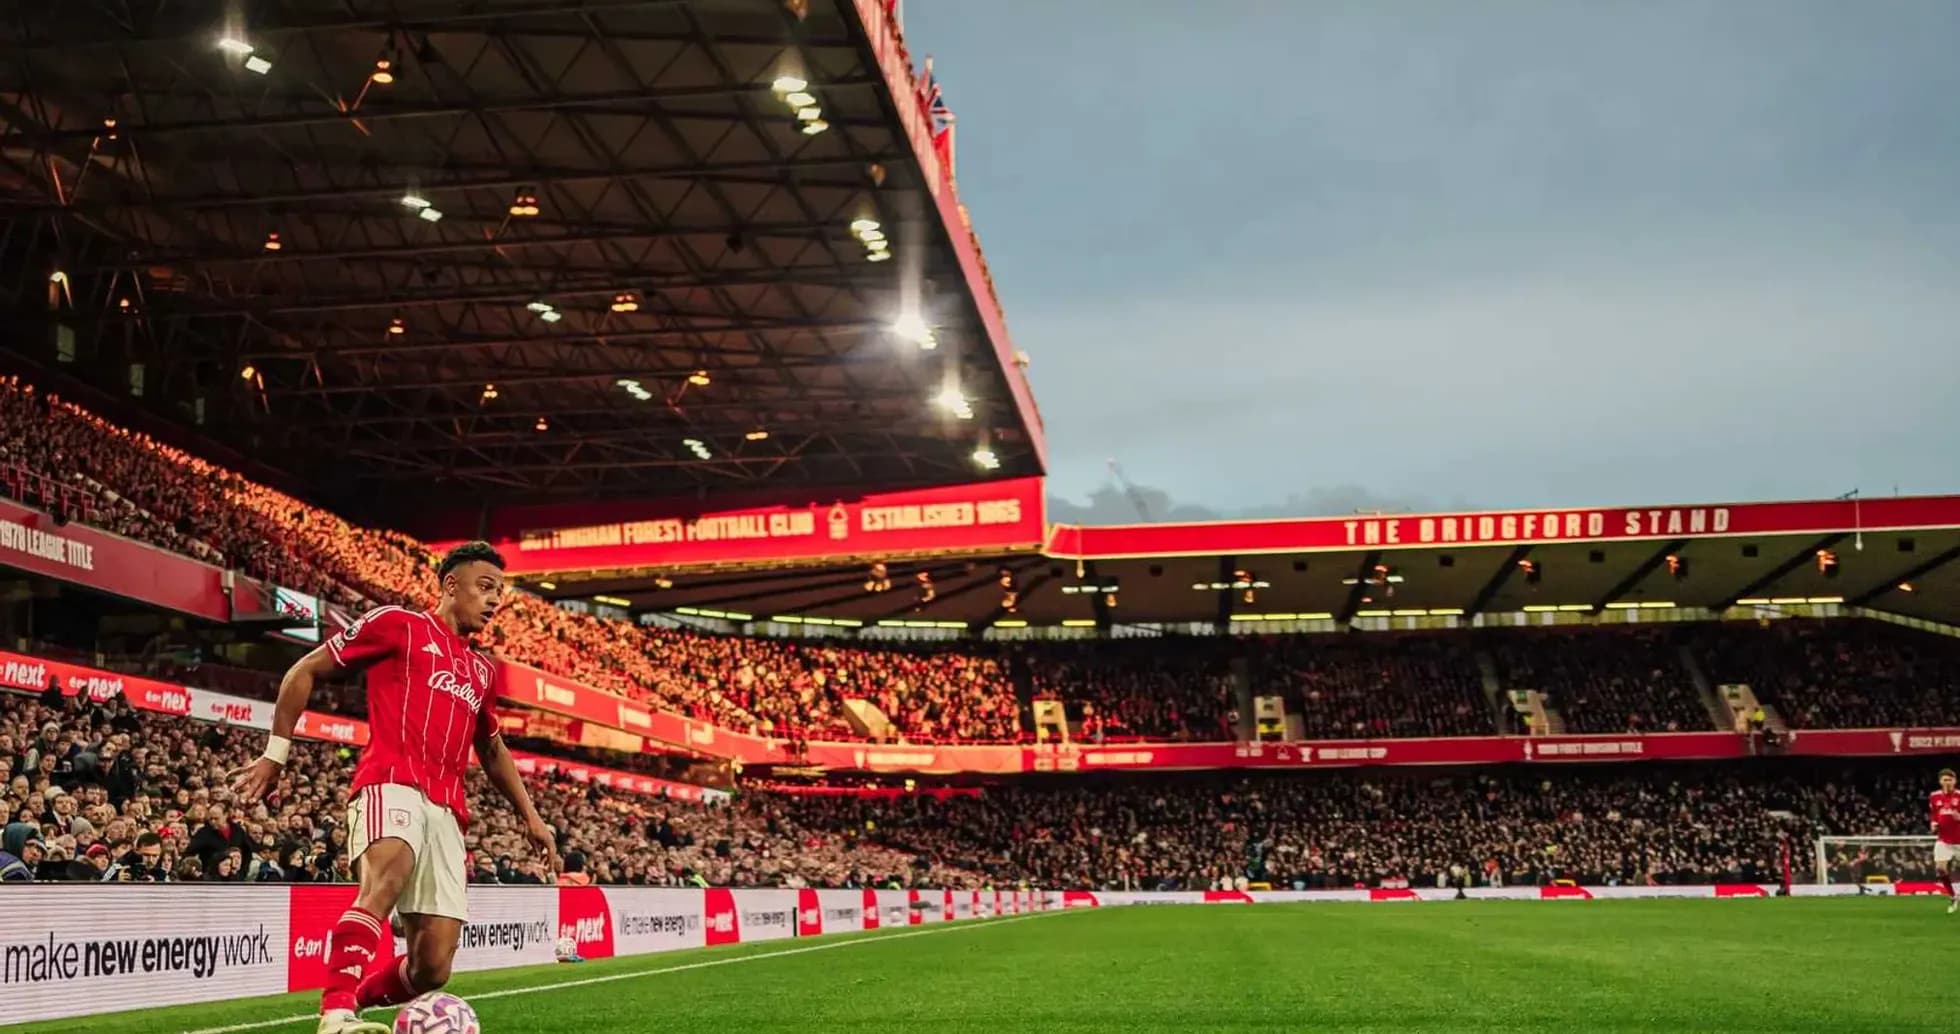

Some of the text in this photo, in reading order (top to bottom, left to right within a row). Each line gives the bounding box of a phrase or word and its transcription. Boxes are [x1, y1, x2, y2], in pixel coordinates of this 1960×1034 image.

[1345, 507, 1730, 545] THE BRIDGFORD STAND
[26, 527, 66, 563] LEAGUE
[66, 538, 95, 571] TITLE
[4, 660, 47, 688] next
[224, 703, 252, 722] next
[462, 922, 487, 948] new
[488, 921, 526, 951] energy
[576, 911, 605, 943] next
[4, 931, 79, 984] make
[84, 939, 138, 977] new
[141, 935, 220, 979] energy
[222, 923, 274, 967] work.
